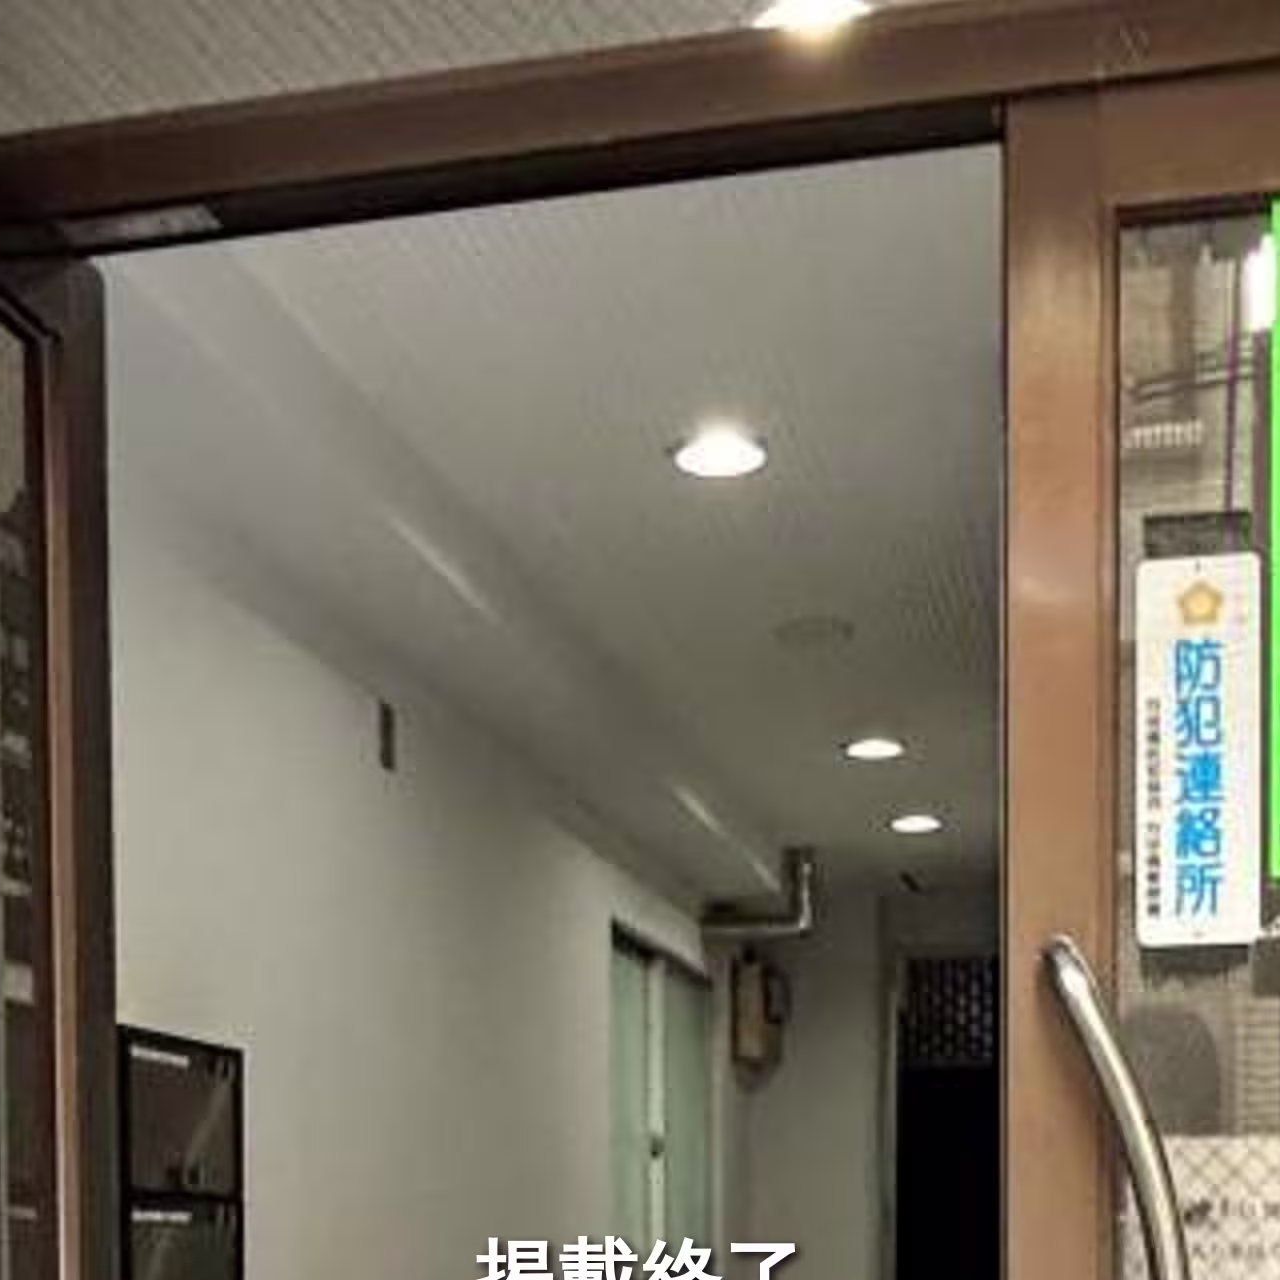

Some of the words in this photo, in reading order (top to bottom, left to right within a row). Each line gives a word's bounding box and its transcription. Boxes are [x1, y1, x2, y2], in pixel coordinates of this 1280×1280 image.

[1174, 639, 1223, 917] 防犯連絡所
